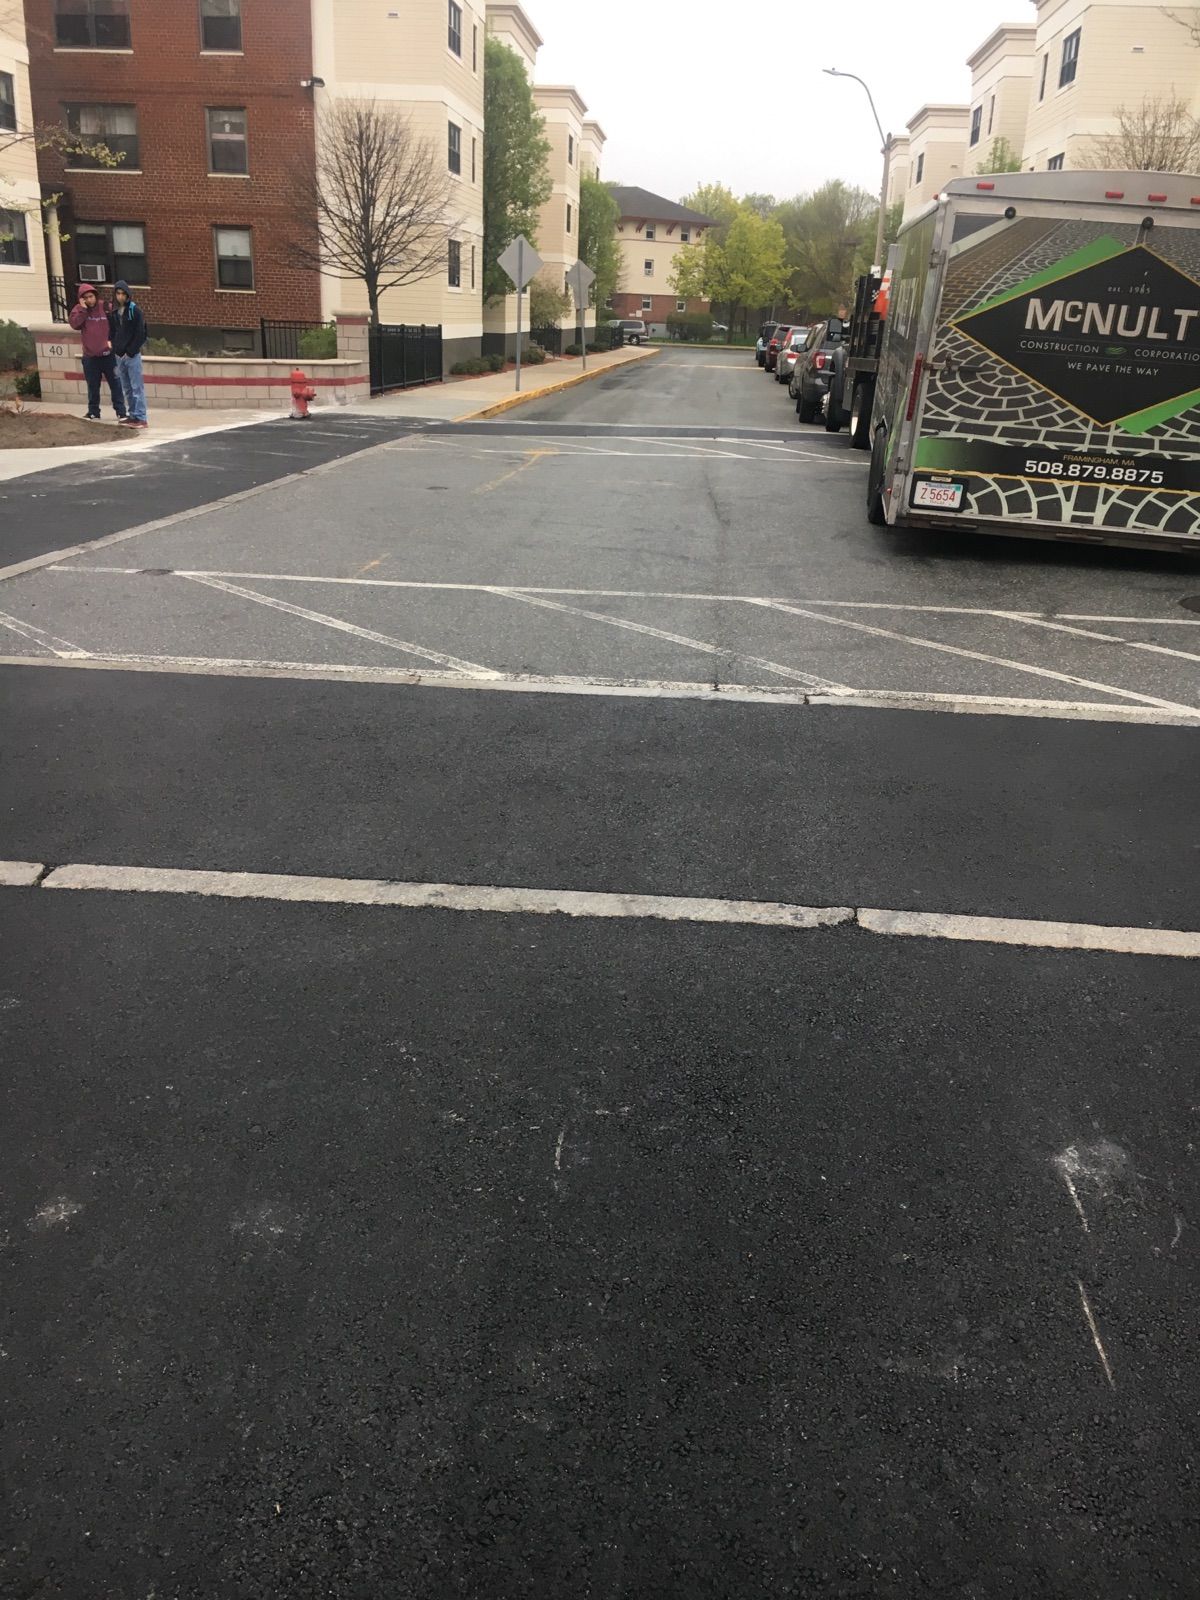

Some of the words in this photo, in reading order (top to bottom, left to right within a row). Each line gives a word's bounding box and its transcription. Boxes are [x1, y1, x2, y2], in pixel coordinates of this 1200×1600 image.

[49, 345, 63, 356] 40
[1019, 340, 1100, 353] CONSTRUCTION
[1067, 361, 1083, 370] WE
[1086, 363, 1111, 372] PAVE
[1115, 365, 1133, 374] THE
[1136, 367, 1160, 376] WAY
[1063, 454, 1120, 465] FRAMINGHAM,
[1024, 459, 1165, 484] 508.879.8875
[920, 487, 928, 500] Z
[929, 488, 956, 502] 5654
